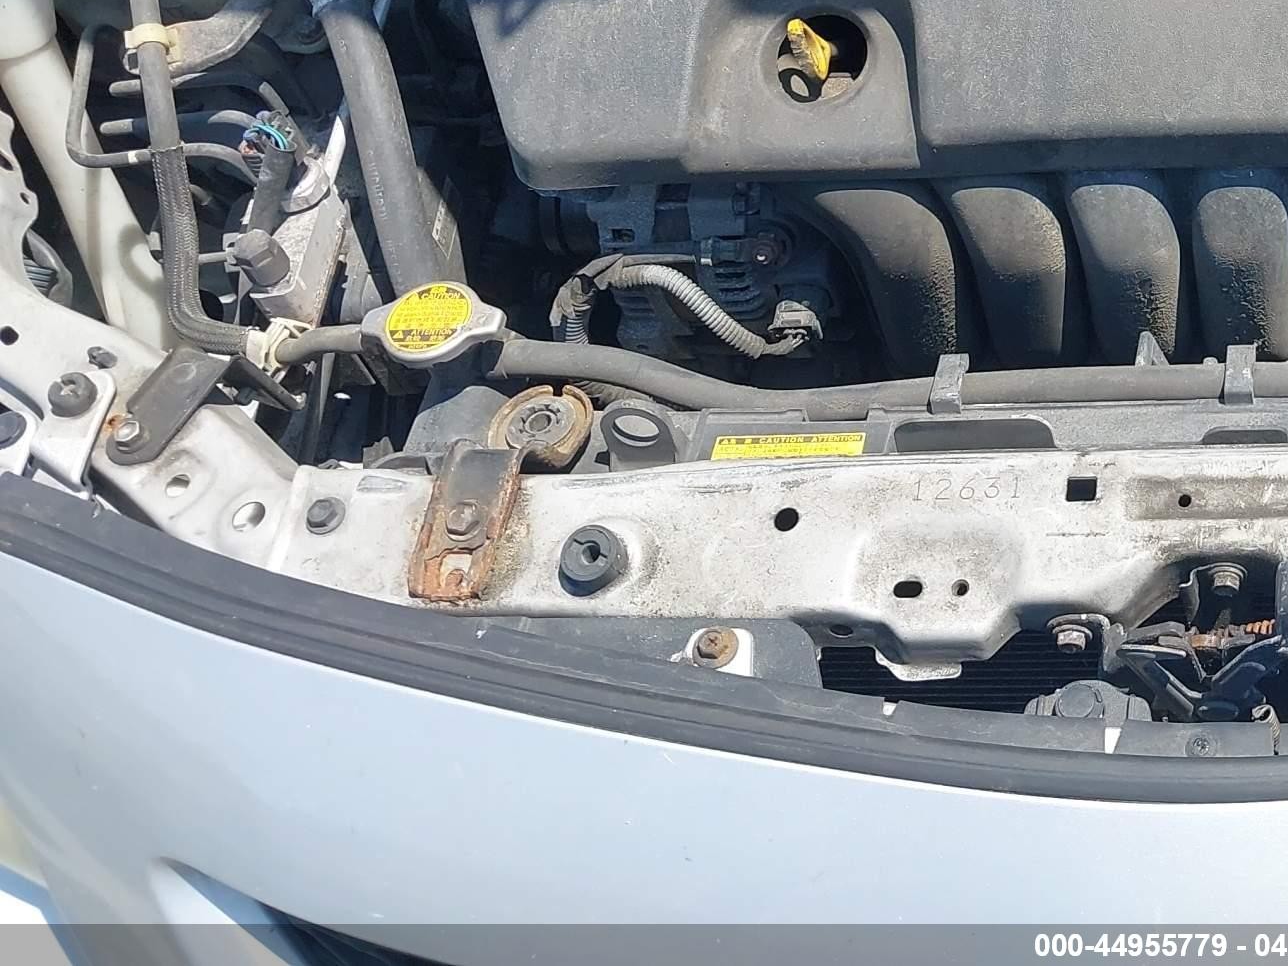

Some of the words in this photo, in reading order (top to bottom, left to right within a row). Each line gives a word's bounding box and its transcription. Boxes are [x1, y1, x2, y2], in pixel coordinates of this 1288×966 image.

[420, 292, 461, 300] CAUTION
[410, 328, 454, 336] ATTENTION
[759, 436, 805, 445] CAUTION
[811, 434, 861, 443] ATTENTION
[912, 476, 1021, 502] 12631
